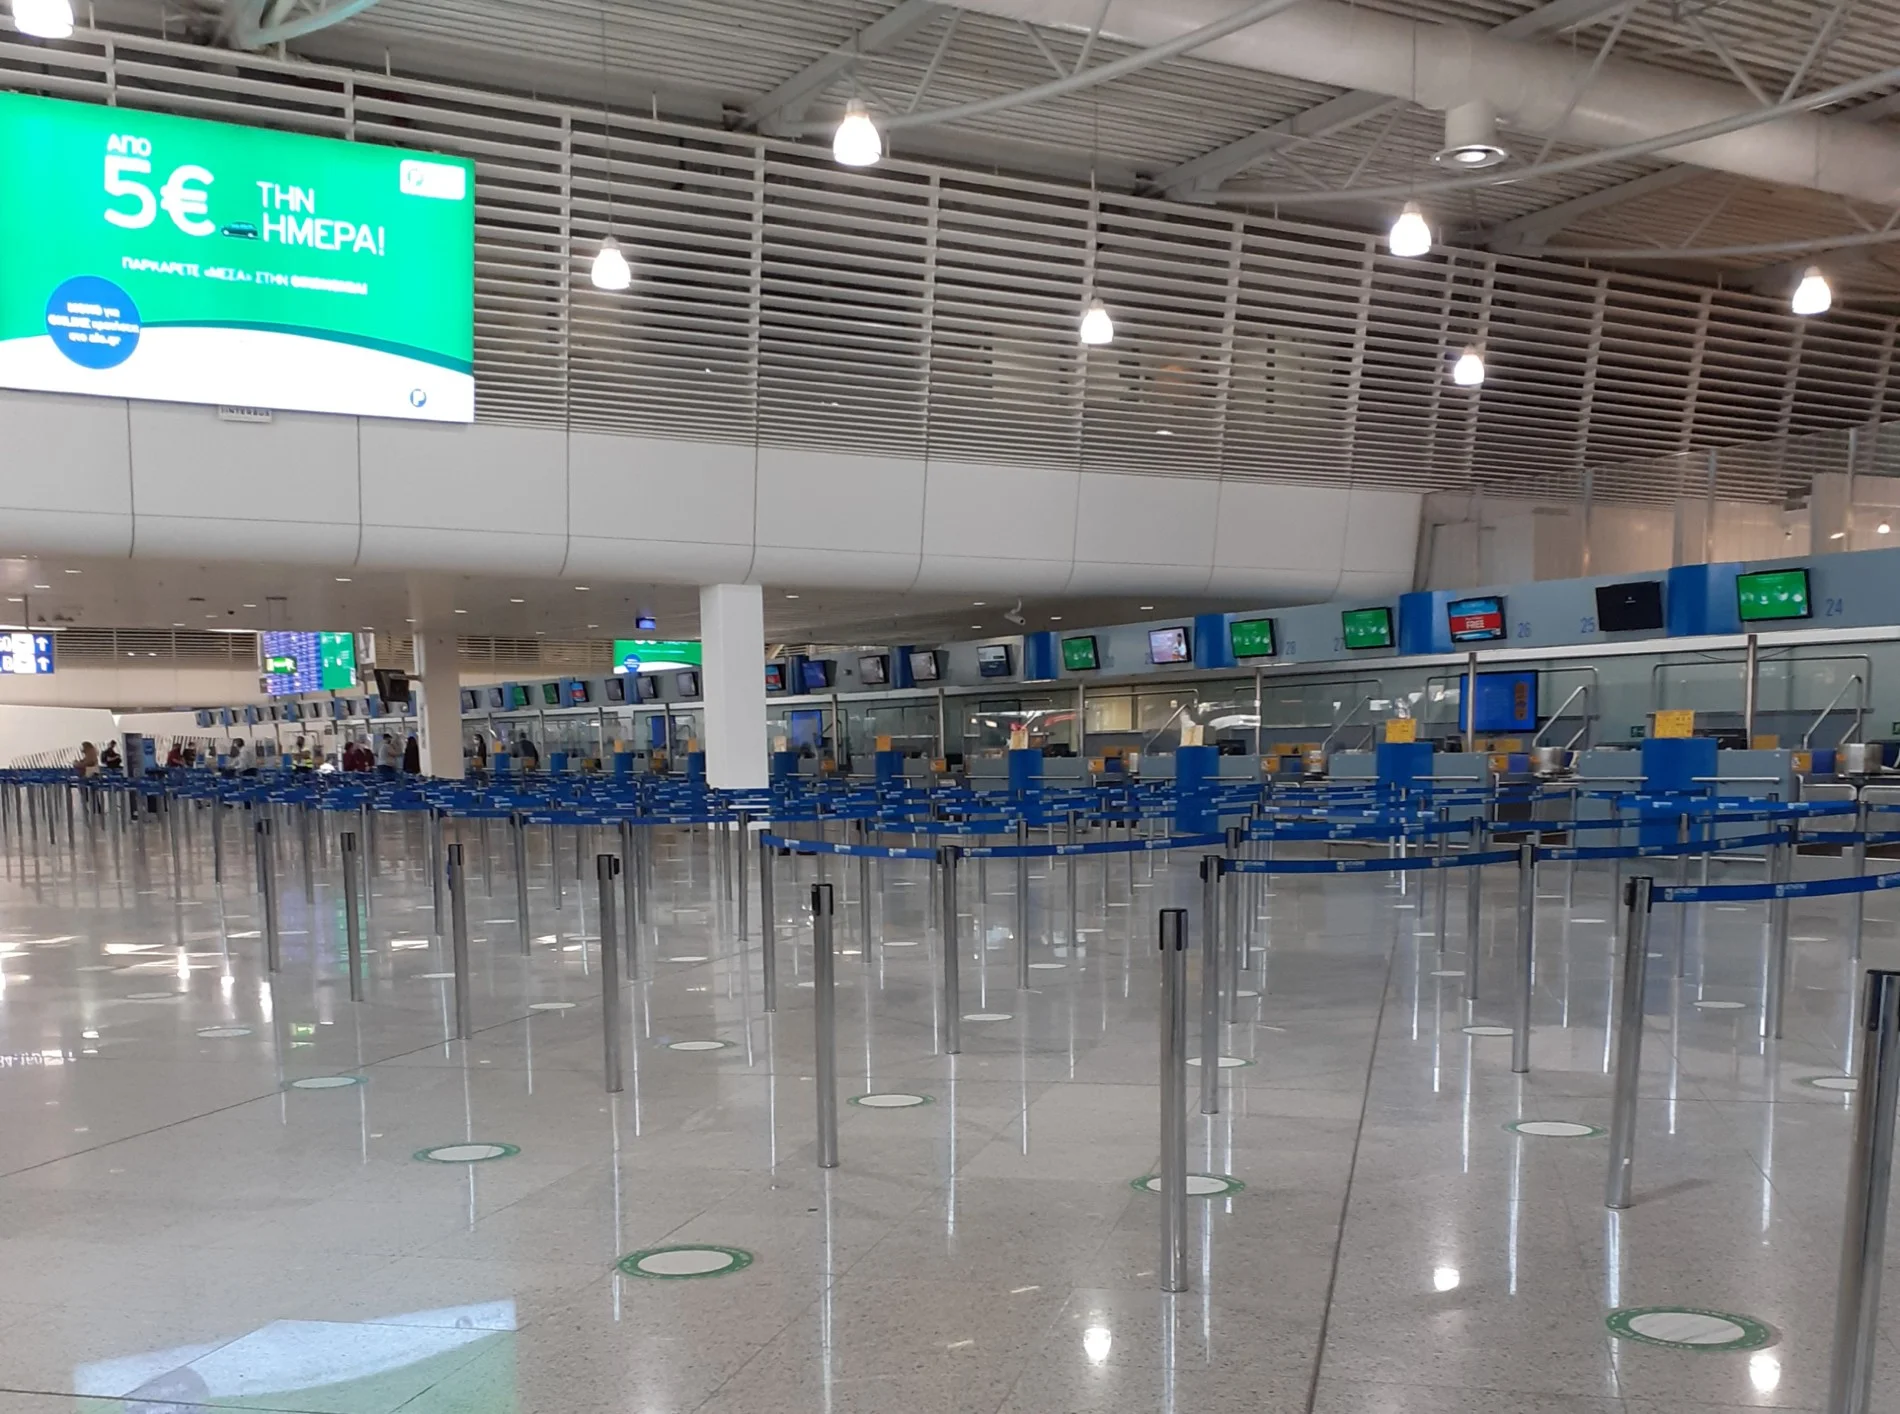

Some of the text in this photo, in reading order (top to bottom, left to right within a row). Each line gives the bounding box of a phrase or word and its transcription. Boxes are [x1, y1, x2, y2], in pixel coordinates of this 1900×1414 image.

[106, 133, 152, 157] ΑΠΟ
[104, 154, 216, 236] 5€
[256, 180, 315, 214] ΤΗΝ
[262, 211, 385, 257] ΗΜΕΡΑ!
[1826, 599, 1842, 616] 24
[1465, 619, 1485, 629] FREE
[1517, 622, 1532, 638] 26
[1580, 617, 1595, 633] 25
